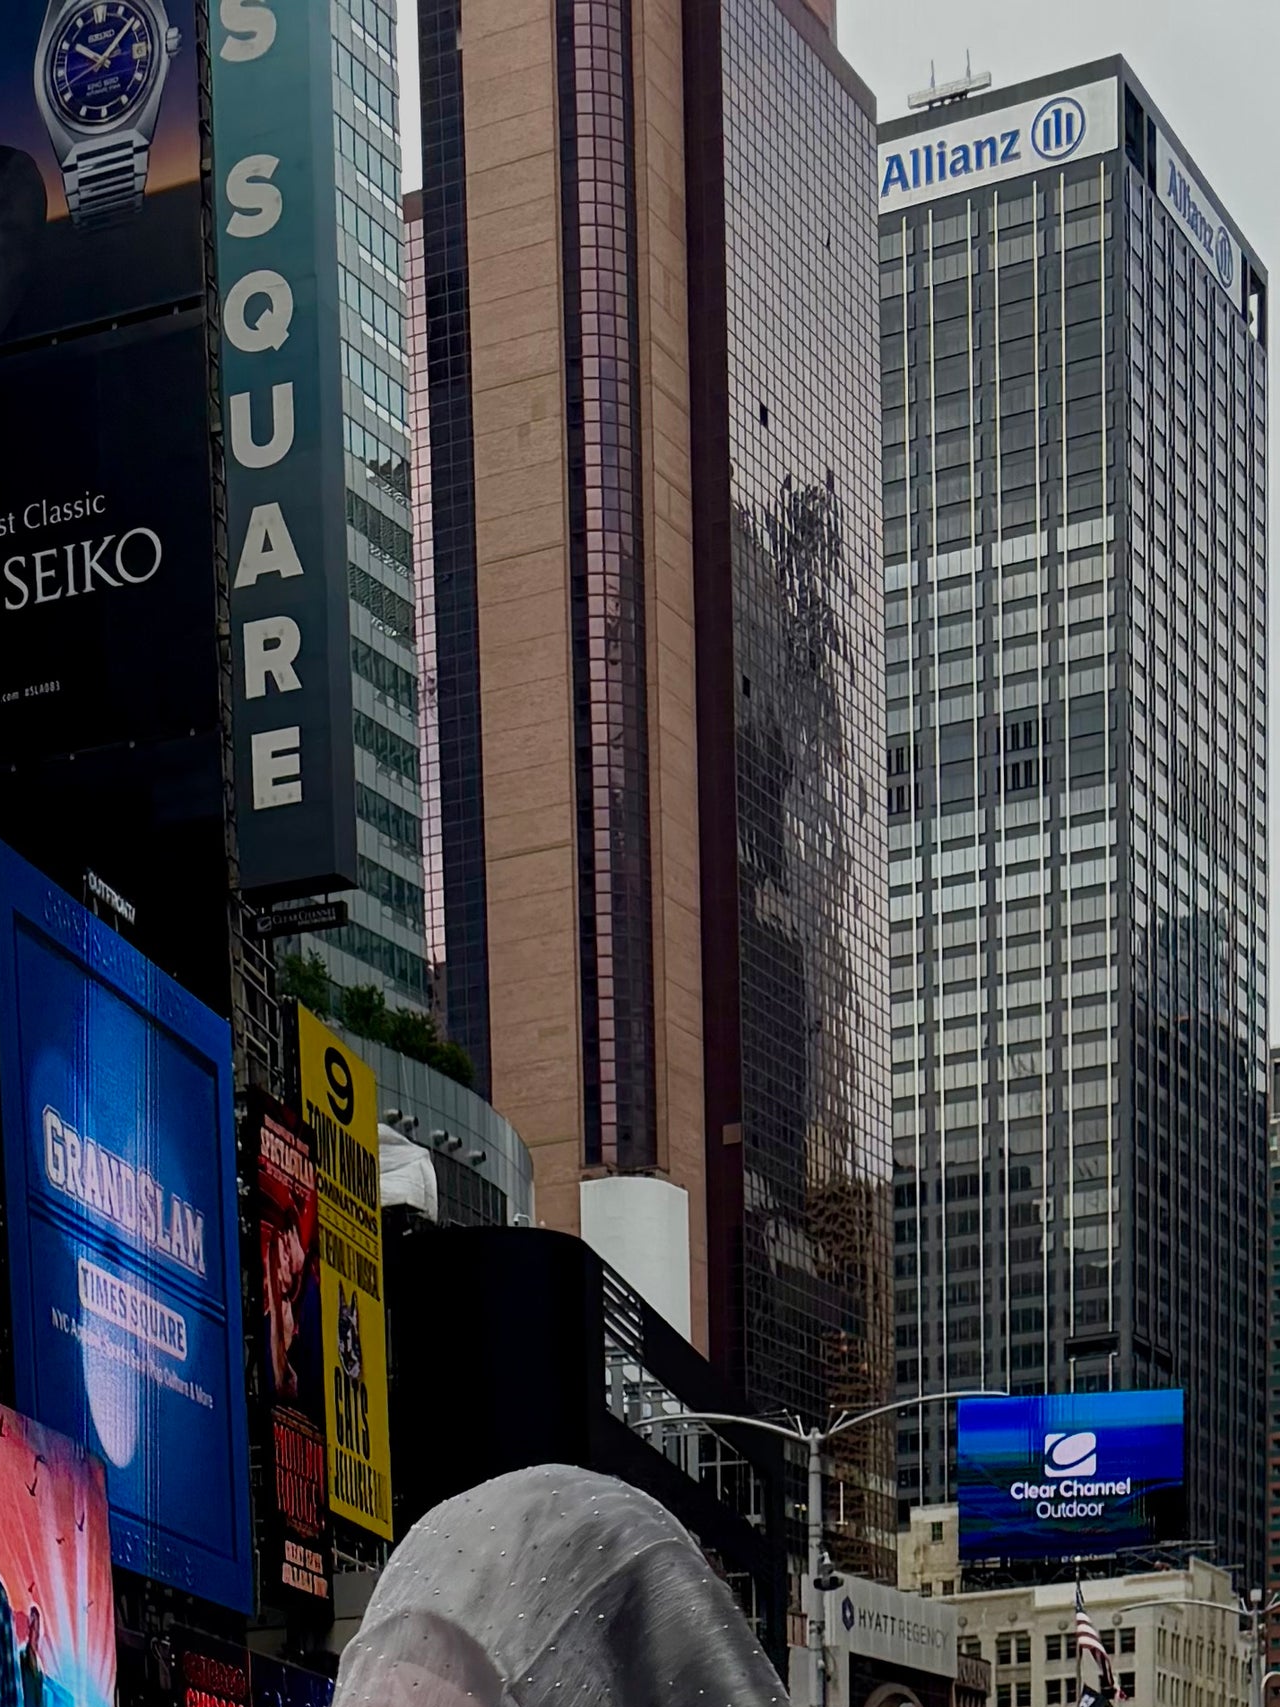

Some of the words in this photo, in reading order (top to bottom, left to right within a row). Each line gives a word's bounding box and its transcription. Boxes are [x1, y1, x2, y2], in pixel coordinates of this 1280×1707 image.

[880, 128, 1022, 199] Allianz
[1167, 158, 1215, 258] Allianz
[22, 489, 108, 534] Classic
[221, 152, 306, 812] SQUARE
[2, 525, 165, 612] SEIKO
[324, 1047, 355, 1127] 9
[81, 1265, 128, 1320] TIMES
[129, 1289, 186, 1354] SQUARE
[1010, 1480, 1057, 1500] Clear
[1059, 1475, 1132, 1497] Channel
[1035, 1500, 1105, 1519] Outdoor
[857, 1607, 897, 1636] HYATT
[897, 1618, 951, 1650] REGENCY
